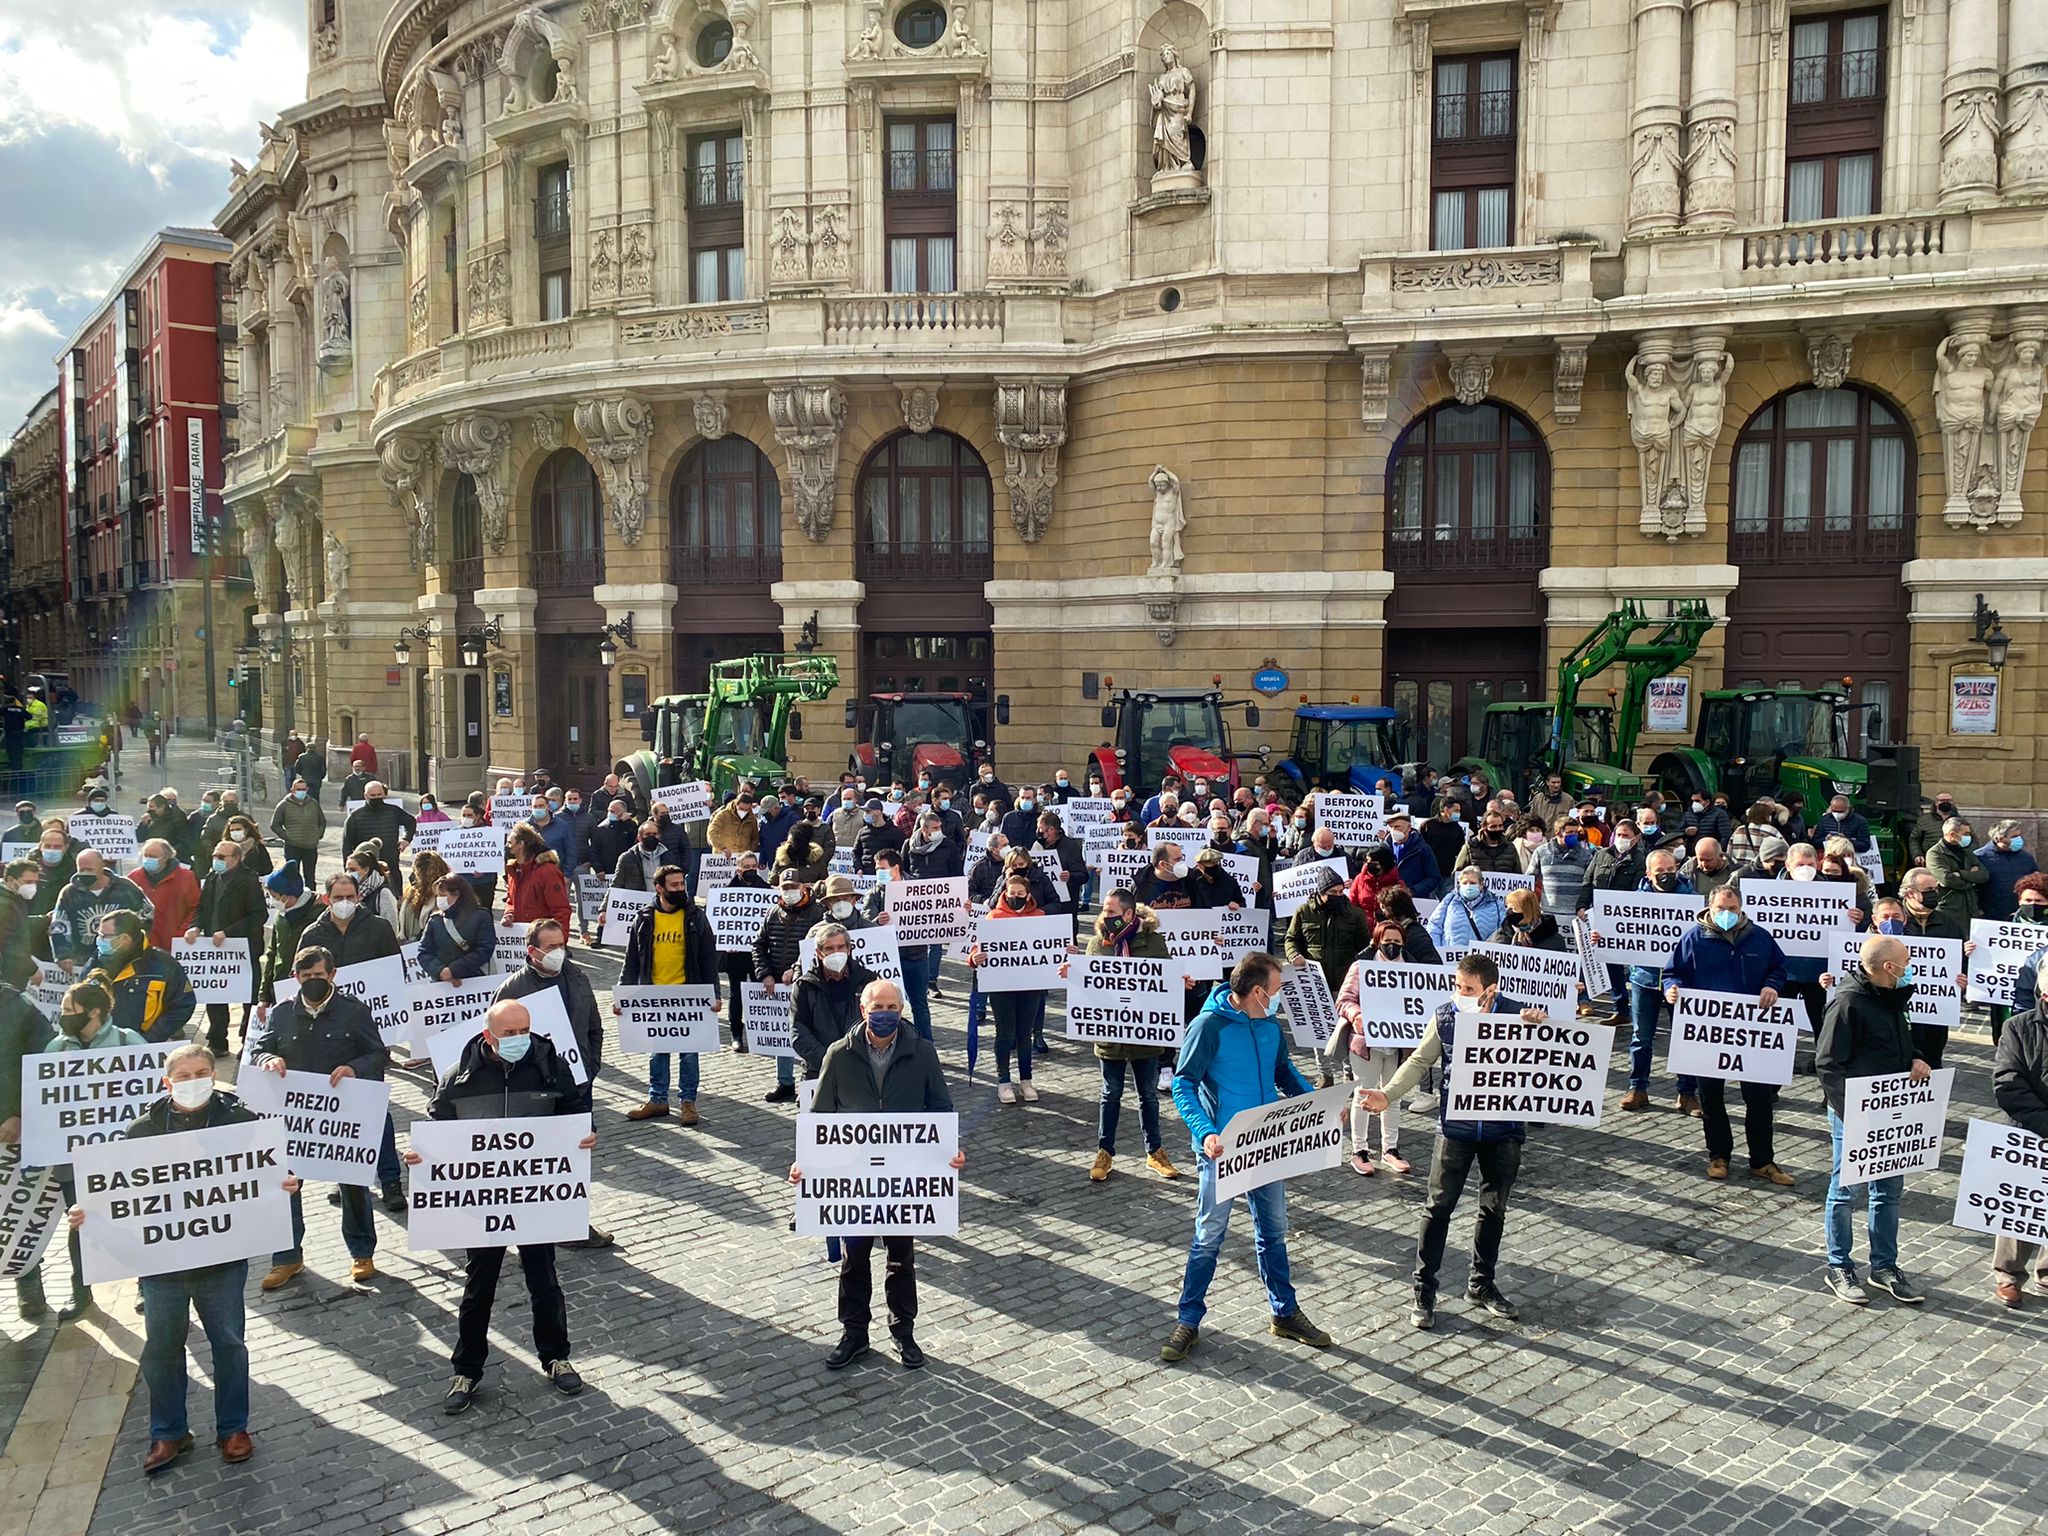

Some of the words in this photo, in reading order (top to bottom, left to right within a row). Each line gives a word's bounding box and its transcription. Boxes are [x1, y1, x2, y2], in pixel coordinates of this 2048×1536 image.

[190, 432, 201, 468] ARANA
[192, 474, 202, 513] PALACE
[657, 783, 700, 799] BASOGINTZA
[669, 801, 708, 814] RALDEAREN
[1324, 797, 1374, 808] BERTOKO
[70, 818, 133, 827] DISTRIBUZIO
[1320, 808, 1378, 820] EKOIZPENA
[84, 828, 125, 836] KATEEK
[1324, 820, 1373, 831] BERTOKO
[460, 832, 483, 840] BASO
[1155, 831, 1206, 841] BASOGINTZA
[100, 847, 132, 855] TUZTE
[445, 840, 497, 850] KUDEAKETA
[463, 860, 476, 868] DA
[906, 883, 950, 897] PRECIOS
[1491, 879, 1506, 891] NOS
[892, 899, 933, 912] DIGNOS
[935, 897, 961, 909] PARA
[1745, 895, 1850, 910] BASERRITIK
[712, 906, 767, 918] EKOIZPE
[898, 912, 955, 926] NUESTRAS
[1603, 904, 1695, 922] BASERRITAR
[1756, 911, 1790, 924] BIZI
[1795, 914, 1839, 926] NAHI
[717, 920, 760, 932] BERTO
[1615, 922, 1683, 938] GEHIAGO
[1772, 928, 1822, 941] DUGU
[1180, 930, 1219, 941] GURE
[980, 940, 1029, 953] ESNEA
[1032, 937, 1071, 950] GURE
[1200, 946, 1219, 956] DA
[1597, 937, 1646, 952] BEHAR
[175, 951, 247, 962] BASERRITIK
[496, 950, 513, 960] BIZI
[981, 955, 1049, 968] JORNALA
[182, 964, 207, 975] BIZI
[210, 963, 241, 975] NAHI
[1089, 959, 1163, 977] GESTIÓN
[1308, 963, 1319, 973] EL
[1521, 955, 1541, 973] NOS
[1543, 958, 1577, 978] AHOGA
[1931, 965, 1948, 979] LA
[192, 979, 228, 989] DUGU
[337, 980, 366, 995] EZIO
[1084, 976, 1169, 993] FORESTAL
[1281, 980, 1298, 996] NOS
[1297, 974, 1311, 985] LA
[1500, 975, 1568, 1000] DISTRIBUCIÓN
[1312, 974, 1330, 1004] PIENSO
[1987, 987, 1996, 998] Y
[412, 991, 496, 1012] BASERRIT
[620, 997, 712, 1008] BASERRITIK
[1403, 997, 1425, 1016] ES
[424, 1012, 456, 1026] BIZI
[631, 1012, 661, 1022] BIZI
[666, 1011, 704, 1022] NAHI
[749, 1005, 783, 1016] EFECTIVO
[1070, 1006, 1144, 1024] GESTIÓN
[1149, 1011, 1181, 1026] DEL
[1286, 997, 1308, 1027] REMATA
[1301, 986, 1327, 1041] DISTRIBUCIÓN
[1321, 1003, 1335, 1022] NOS
[1679, 997, 1795, 1026] KUDEATZEA
[647, 1027, 690, 1038] DUGU
[747, 1020, 759, 1031] LEY
[760, 1021, 770, 1031] DE
[771, 1021, 781, 1032] LA
[1075, 1022, 1176, 1042] TERRITORIO
[1367, 1020, 1426, 1040] CONSE
[1477, 1022, 1590, 1046] BERTOKO
[757, 1036, 791, 1048] ALIMENTA
[1683, 1023, 1785, 1051] BABESTEA
[1464, 1047, 1598, 1071] EKOIZPENA
[1717, 1052, 1744, 1073] DA
[41, 1075, 166, 1105] HILTEGIA
[1472, 1071, 1583, 1092] BERTOKO
[1870, 1075, 1931, 1095] SECTOR
[284, 1091, 340, 1113] PREZIO
[1454, 1095, 1596, 1118] MERKATURA
[1861, 1089, 1935, 1112] FORESTAL
[1263, 1100, 1314, 1123] PREZIO
[319, 1118, 361, 1140] GURE
[815, 1123, 940, 1145] BASOGINTZA
[1235, 1120, 1288, 1149] DUINAK
[1289, 1109, 1326, 1132] GURE
[1866, 1122, 1924, 1144] SECTOR
[66, 1129, 126, 1153] DOG
[471, 1131, 535, 1152] BASO
[1848, 1135, 1938, 1163] SOSTENIBLE
[286, 1139, 377, 1165] ENETARAKO
[1217, 1127, 1341, 1180] EKOIZPENETARAKO
[87, 1147, 278, 1193] BASERRITIK
[431, 1156, 572, 1181] KUDEAKETA
[1858, 1164, 1866, 1177] Y
[1868, 1154, 1925, 1175] ESENCIAL
[413, 1182, 587, 1209] BEHARREZKOA
[801, 1176, 954, 1199] LURRALDEAREN
[110, 1191, 172, 1220] BIZI
[183, 1179, 260, 1210] NAHI
[819, 1204, 936, 1225] KUDEAKETA
[1983, 1212, 1996, 1227] Y
[143, 1214, 233, 1245] DUGU
[485, 1214, 516, 1233] DA
